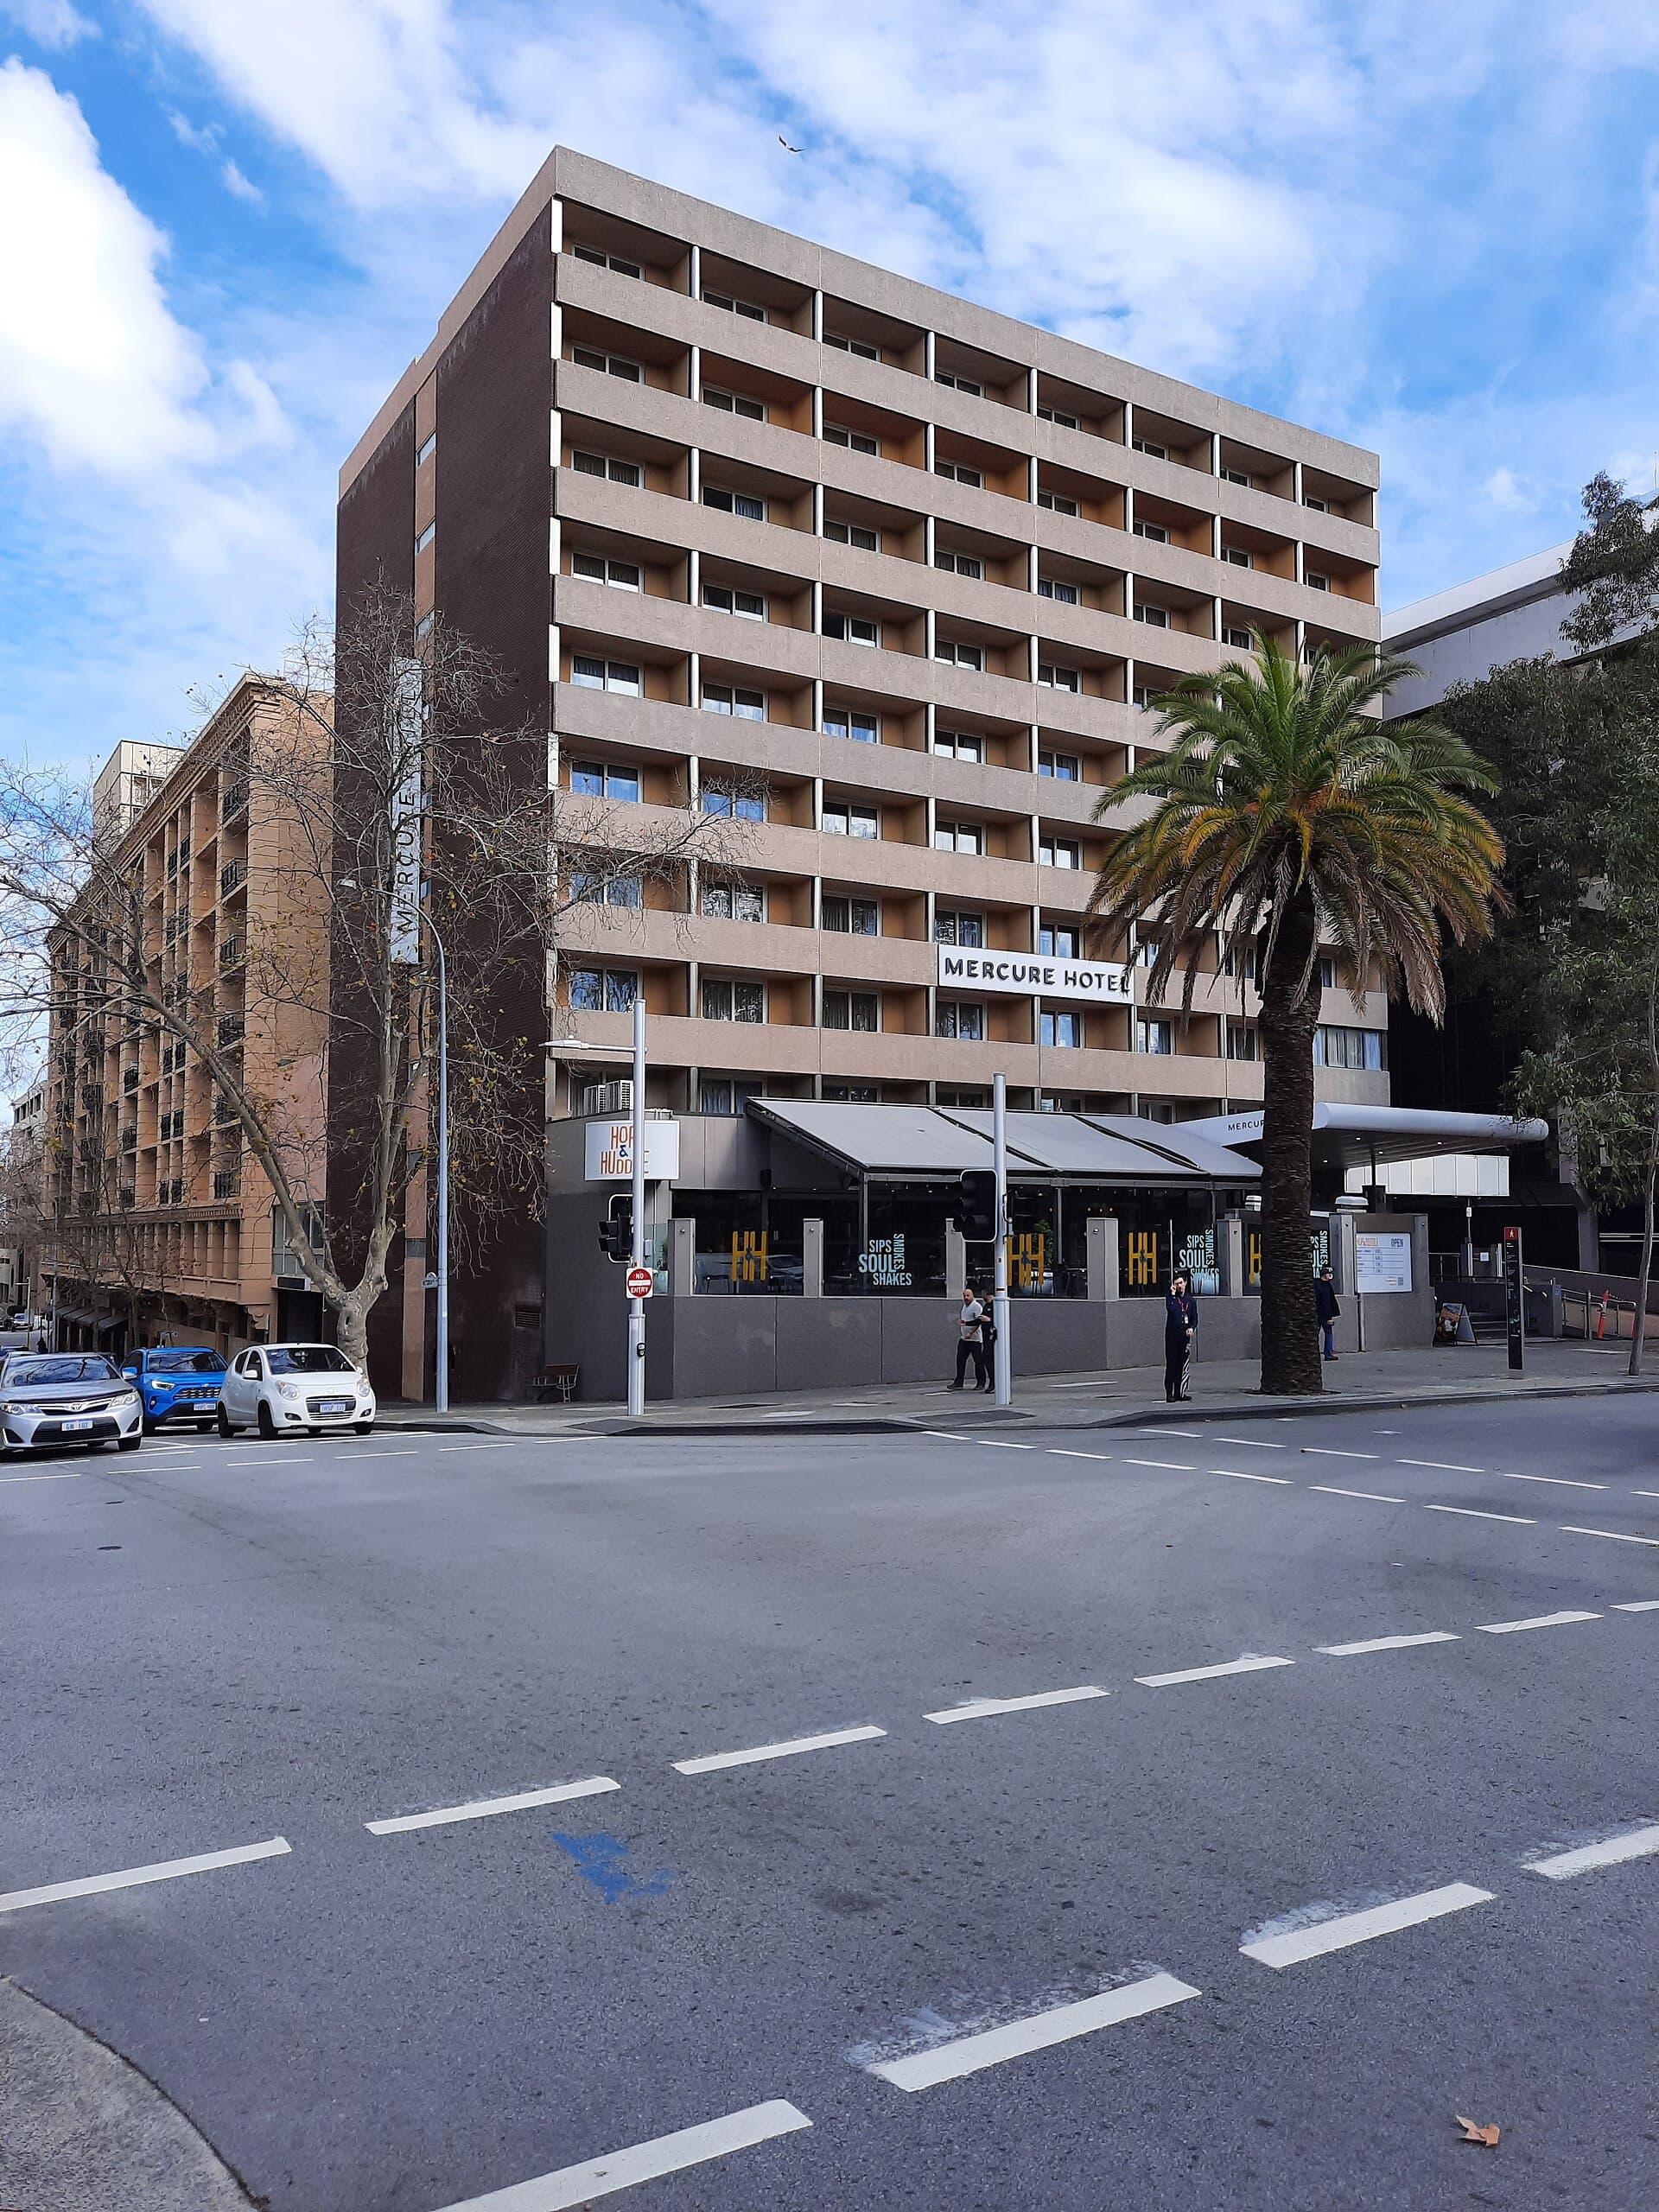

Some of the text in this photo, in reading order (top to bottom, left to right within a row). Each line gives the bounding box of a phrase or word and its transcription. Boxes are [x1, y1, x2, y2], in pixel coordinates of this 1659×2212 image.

[944, 957, 1131, 993] MERCURE HOTEL
[620, 1145, 628, 1157] &
[601, 1151, 650, 1174] HUDDE
[869, 1239, 892, 1253] SIPS
[893, 1233, 905, 1269] SMOKES
[1187, 1235, 1205, 1249] SIPS
[1205, 1229, 1214, 1265] SMOKES
[1320, 1230, 1329, 1265] SMOKES
[858, 1254, 896, 1273] SOUL
[1179, 1249, 1209, 1268] SOUL
[873, 1273, 912, 1286] SHAKES
[1191, 1268, 1219, 1281] SHAKES
